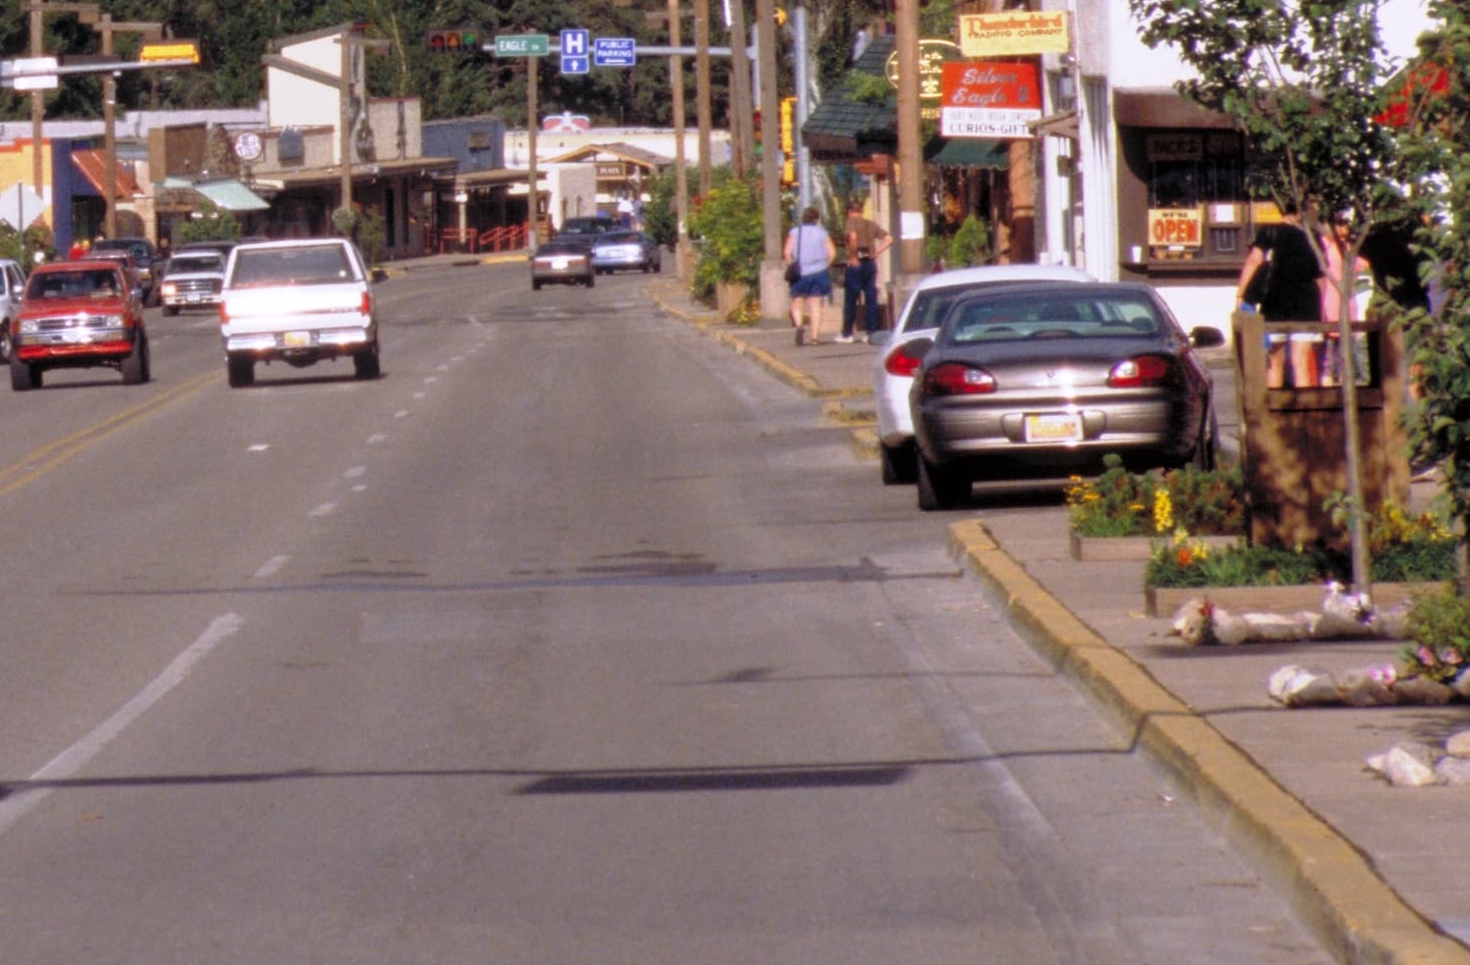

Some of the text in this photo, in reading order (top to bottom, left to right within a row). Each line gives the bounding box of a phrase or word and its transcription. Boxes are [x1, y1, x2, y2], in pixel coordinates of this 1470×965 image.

[967, 14, 1062, 34] Thunderbird
[1018, 26, 1063, 37] COMPANY
[499, 39, 528, 52] EAGLE
[565, 33, 584, 53] H
[600, 40, 630, 49] PUBLIC
[597, 49, 632, 59] PARKING
[962, 68, 1018, 85] Silver
[951, 87, 1008, 106] Eagle
[1153, 219, 1198, 242] OPEN
